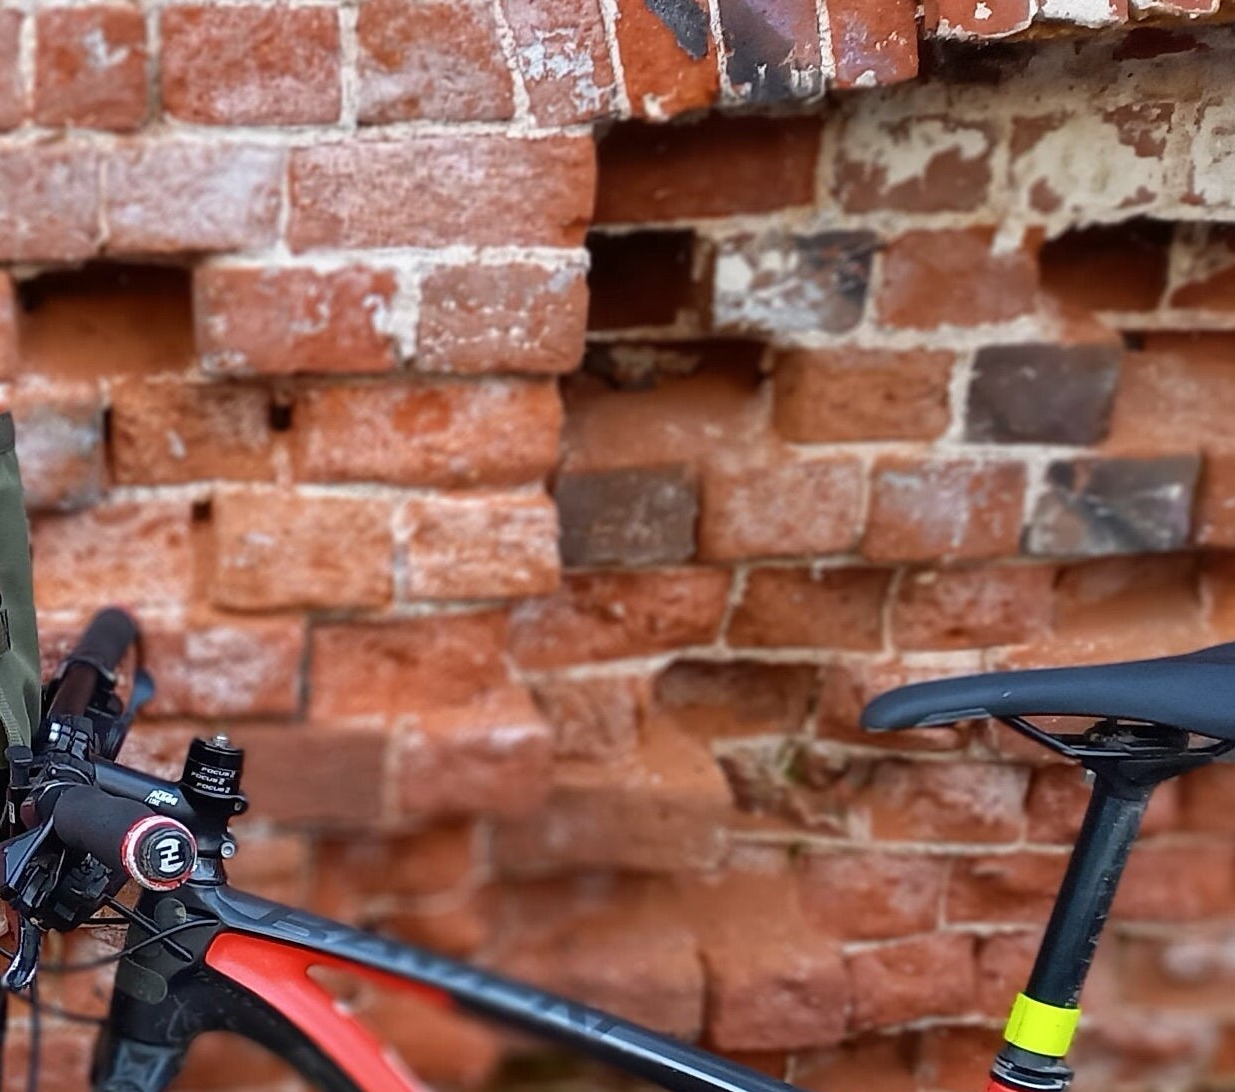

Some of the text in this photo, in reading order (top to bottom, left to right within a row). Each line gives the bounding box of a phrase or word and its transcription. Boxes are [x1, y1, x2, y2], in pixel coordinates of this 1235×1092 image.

[191, 771, 218, 783] FOCUS
[201, 766, 229, 777] FOCUS
[196, 782, 224, 792] FOCUS
